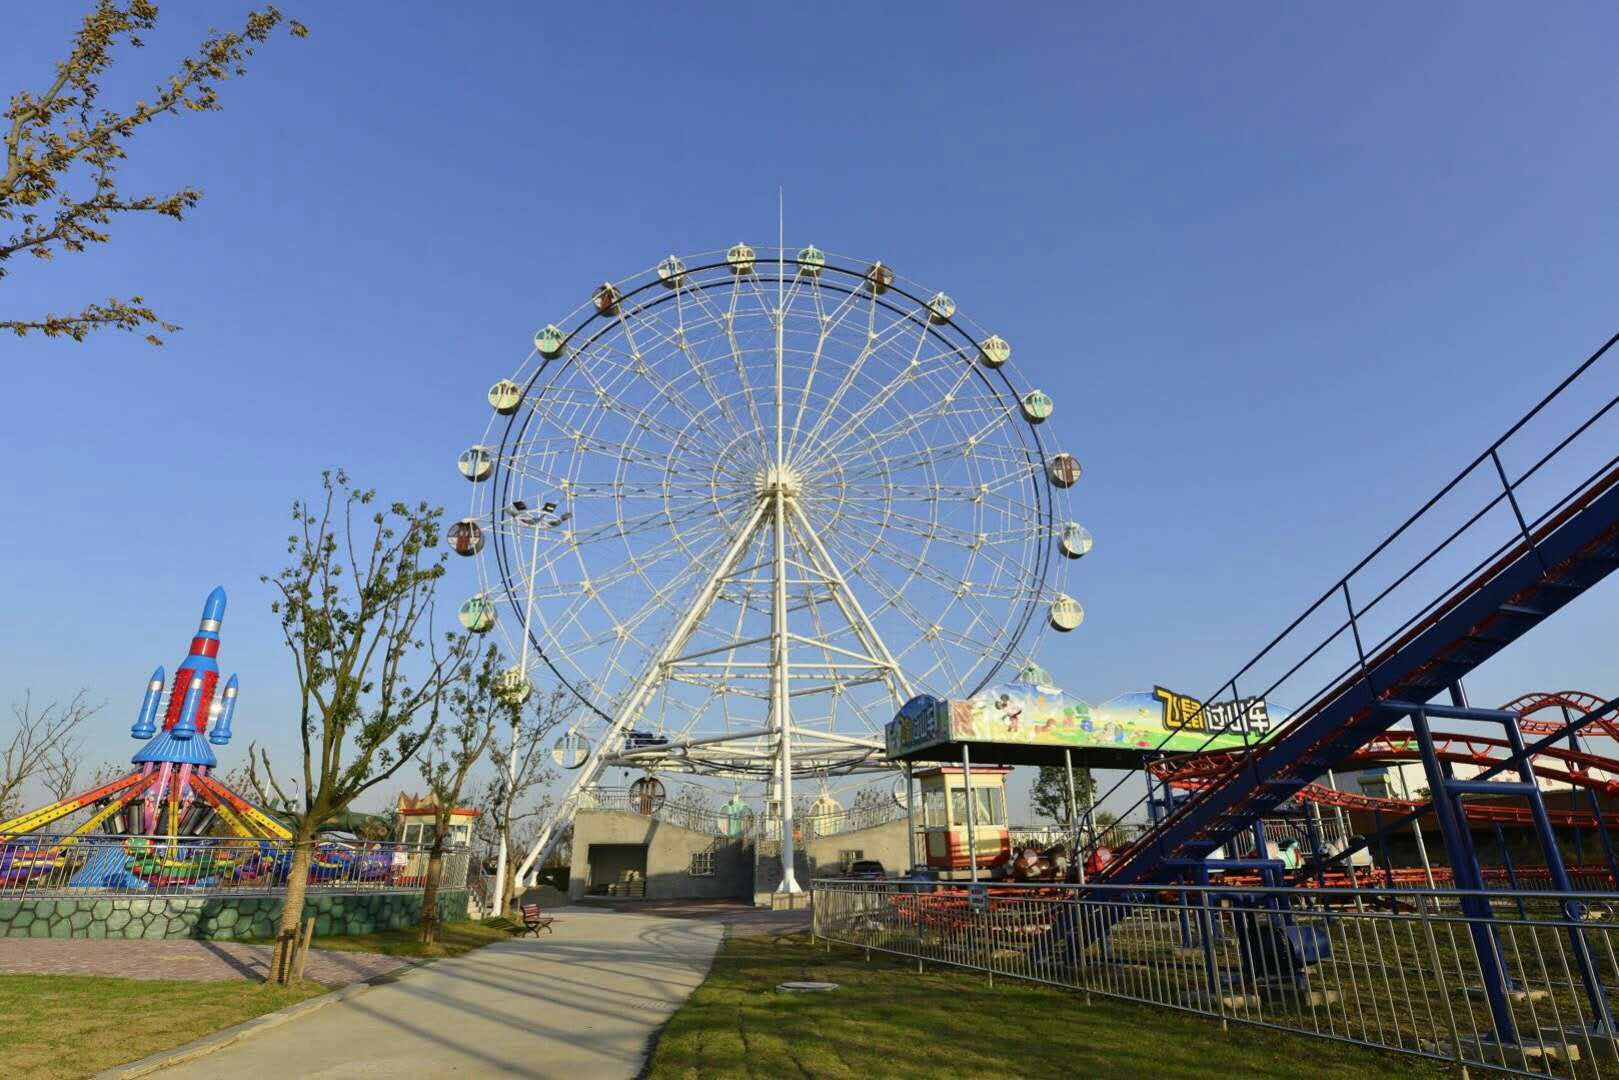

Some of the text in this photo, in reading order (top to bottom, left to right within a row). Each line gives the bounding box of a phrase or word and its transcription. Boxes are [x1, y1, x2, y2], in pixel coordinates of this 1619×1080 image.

[1155, 688, 1269, 734] 飞鼠过山车
